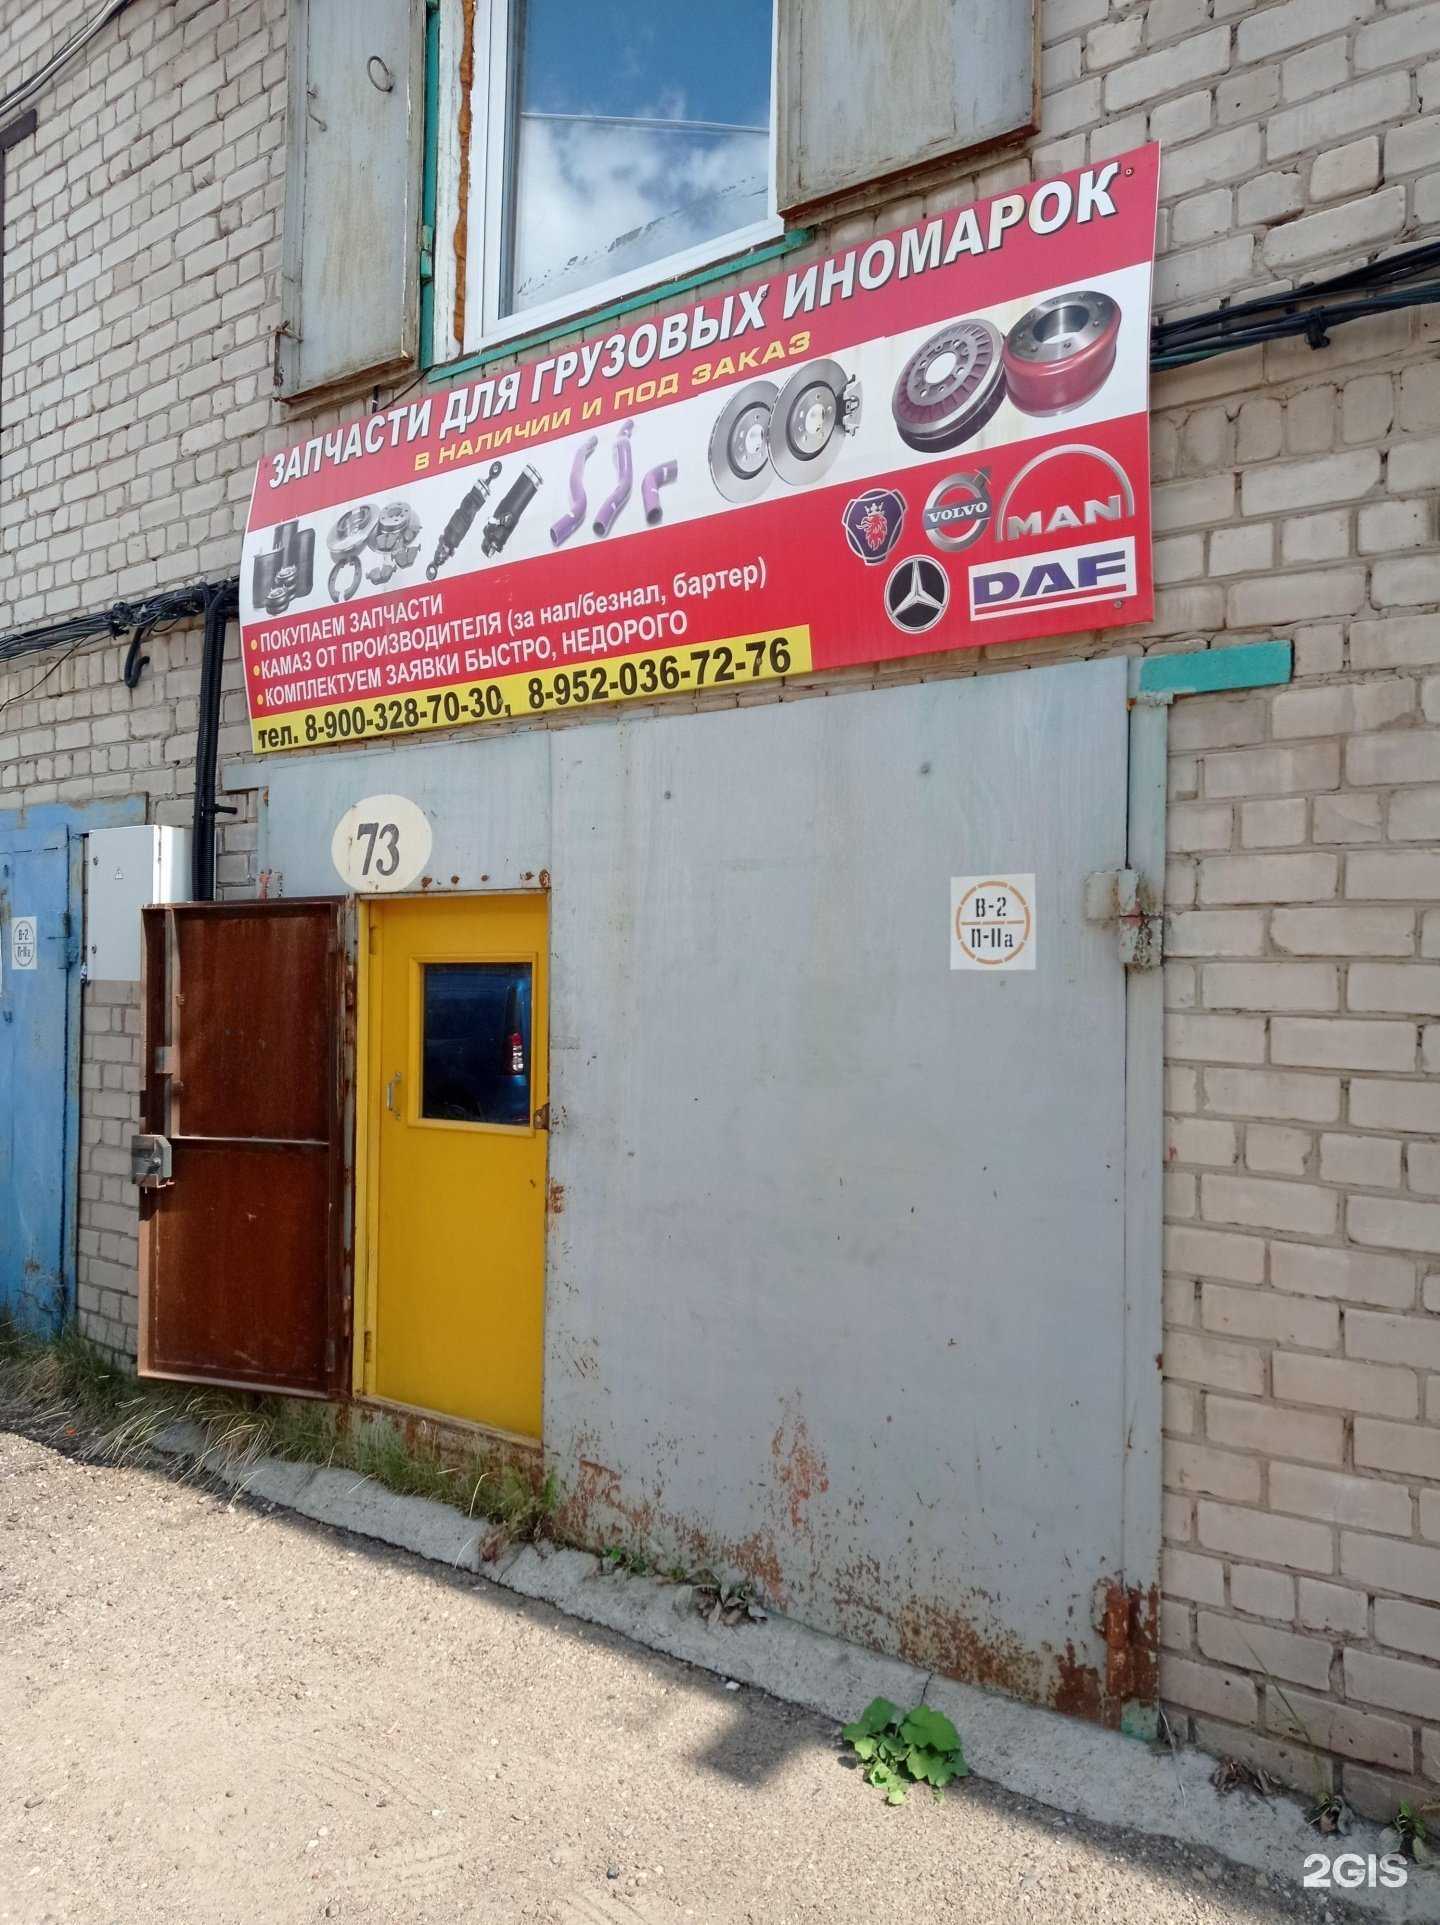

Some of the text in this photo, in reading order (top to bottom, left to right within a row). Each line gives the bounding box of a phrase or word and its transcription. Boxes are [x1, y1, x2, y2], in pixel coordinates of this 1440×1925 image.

[269, 162, 1120, 489] ЗАПЧАСТИ ДЛЯ ГРУЗОВЫХ ИНОМАРОК
[415, 331, 811, 471] В НАЛИЧИИ И ПОД ЗАКАЗ
[927, 501, 989, 524] VOLVO
[1007, 494, 1121, 541] MAN
[973, 550, 1126, 605] DAF
[260, 593, 443, 652] ПОКУПАЕМ ЗАПЧАСТИ
[261, 556, 767, 680] КАМАЗ ОТ ПРОИЗВОДИТЕЛЯ (за нал/безнал, бартер)
[265, 610, 688, 707] КОМПЛЕКТУЕМ ЗАЯВКИ БЫСТРО, НЕДОРОГО
[257, 636, 792, 749] тел. 8-900-328-70-30, 8-952-036-72-76
[356, 822, 399, 876] 73
[975, 896, 1007, 918] В-2
